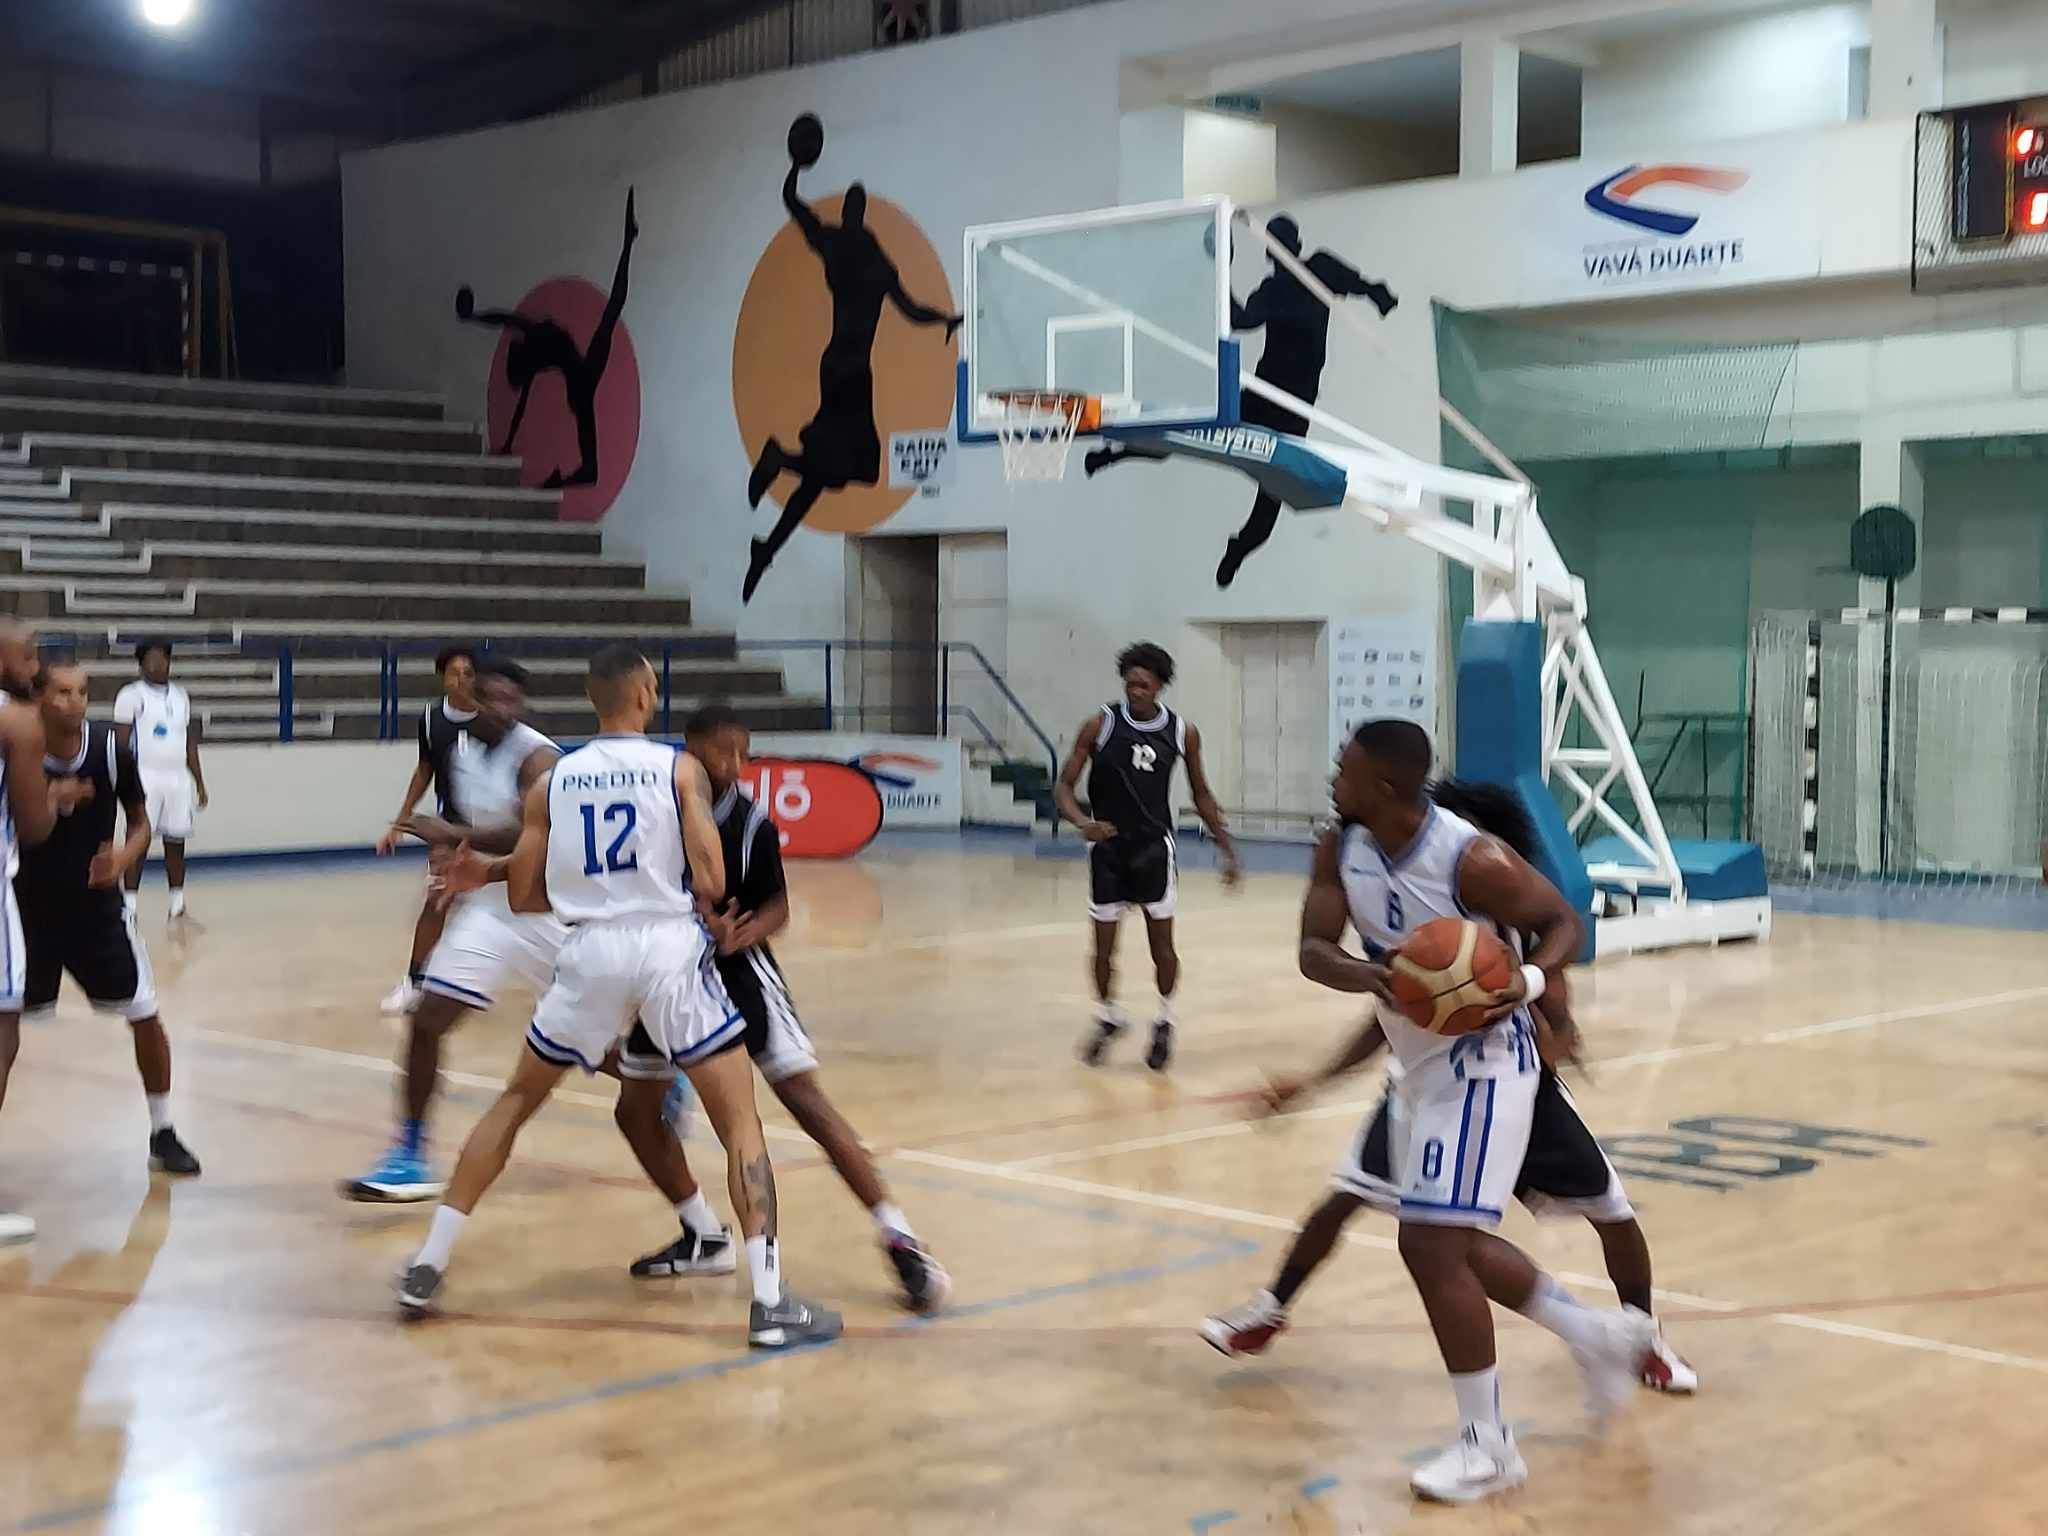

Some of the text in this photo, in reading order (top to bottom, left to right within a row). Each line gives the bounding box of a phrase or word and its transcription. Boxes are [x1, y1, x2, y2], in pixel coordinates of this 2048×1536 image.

[1583, 245, 1643, 279] VAVÁ
[1650, 240, 1744, 272] DUARTE
[887, 792, 942, 809] DUARTE
[579, 803, 638, 877] 12
